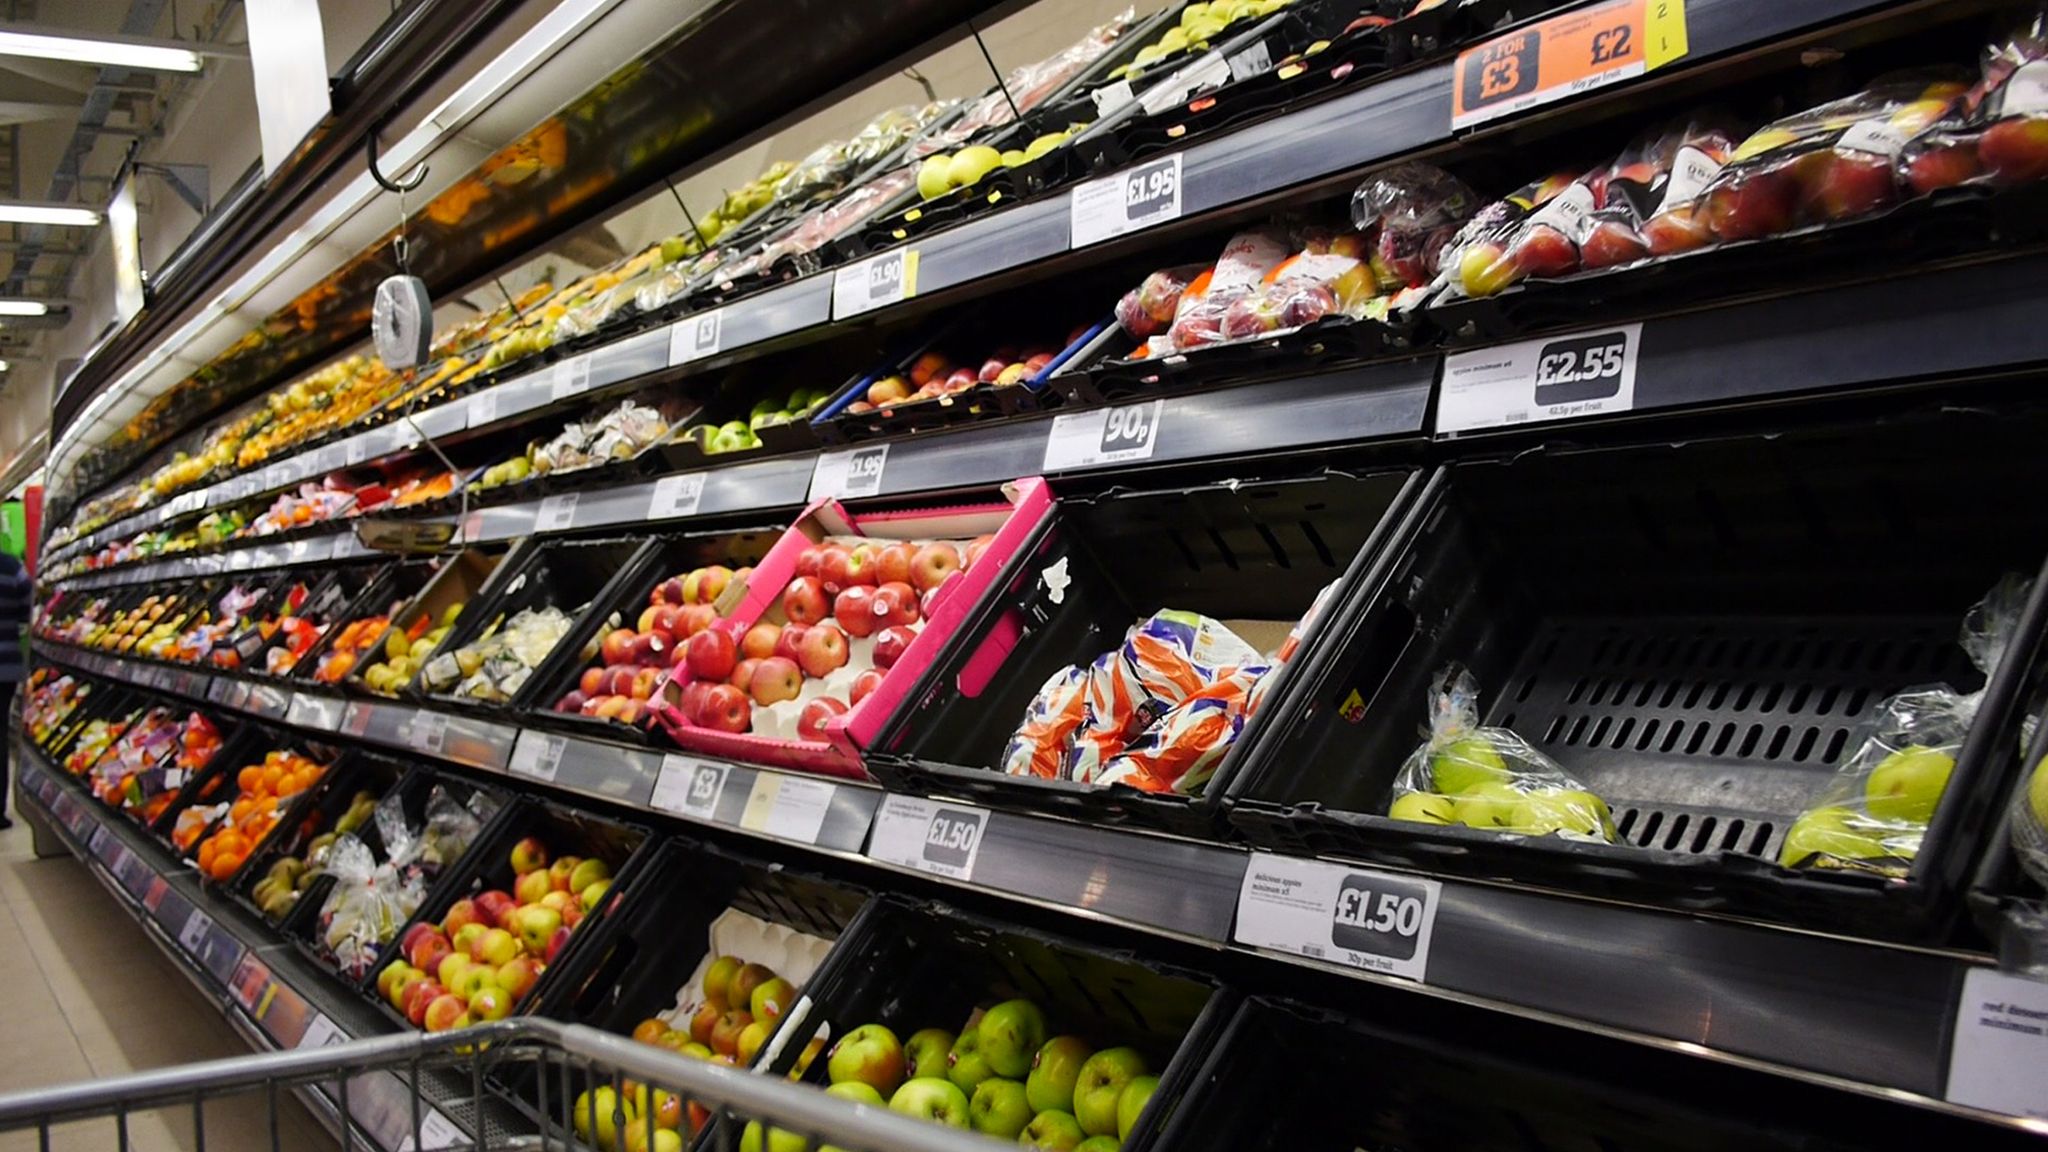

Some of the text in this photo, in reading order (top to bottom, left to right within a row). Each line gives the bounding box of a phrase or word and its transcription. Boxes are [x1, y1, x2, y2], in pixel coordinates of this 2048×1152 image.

[1482, 49, 1493, 64] 2
[1496, 35, 1526, 60] FOR
[1590, 24, 1632, 67] £2
[1480, 56, 1521, 99] £3
[1127, 166, 1174, 207] £1.95
[1536, 344, 1624, 386] £2.55
[1105, 405, 1149, 444] 90p
[1584, 402, 1603, 412] fruit
[692, 768, 718, 799] £3
[927, 817, 977, 852] £1.50
[1281, 878, 1303, 889] apples
[1335, 888, 1423, 938] £1.50
[1347, 952, 1394, 971] 30p per fruit
